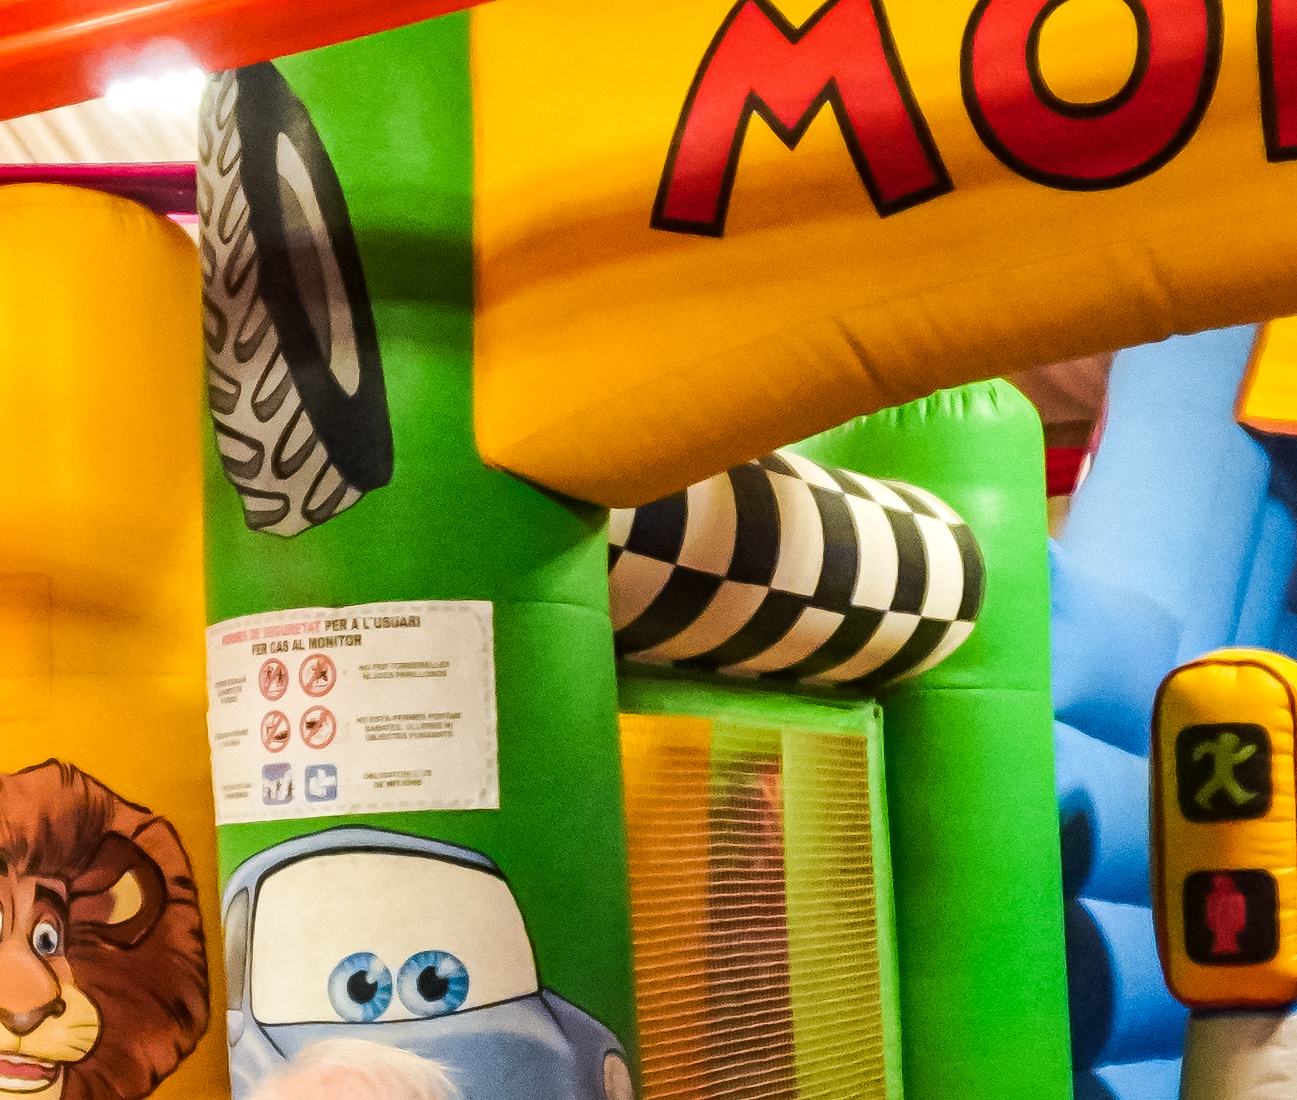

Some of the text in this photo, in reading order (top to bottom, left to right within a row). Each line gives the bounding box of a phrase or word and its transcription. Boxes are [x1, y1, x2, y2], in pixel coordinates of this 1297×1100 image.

[325, 618, 347, 632] PER
[351, 618, 359, 630] A
[270, 640, 289, 654] CAS
[292, 638, 305, 651] AL
[308, 634, 362, 650] MONITOR
